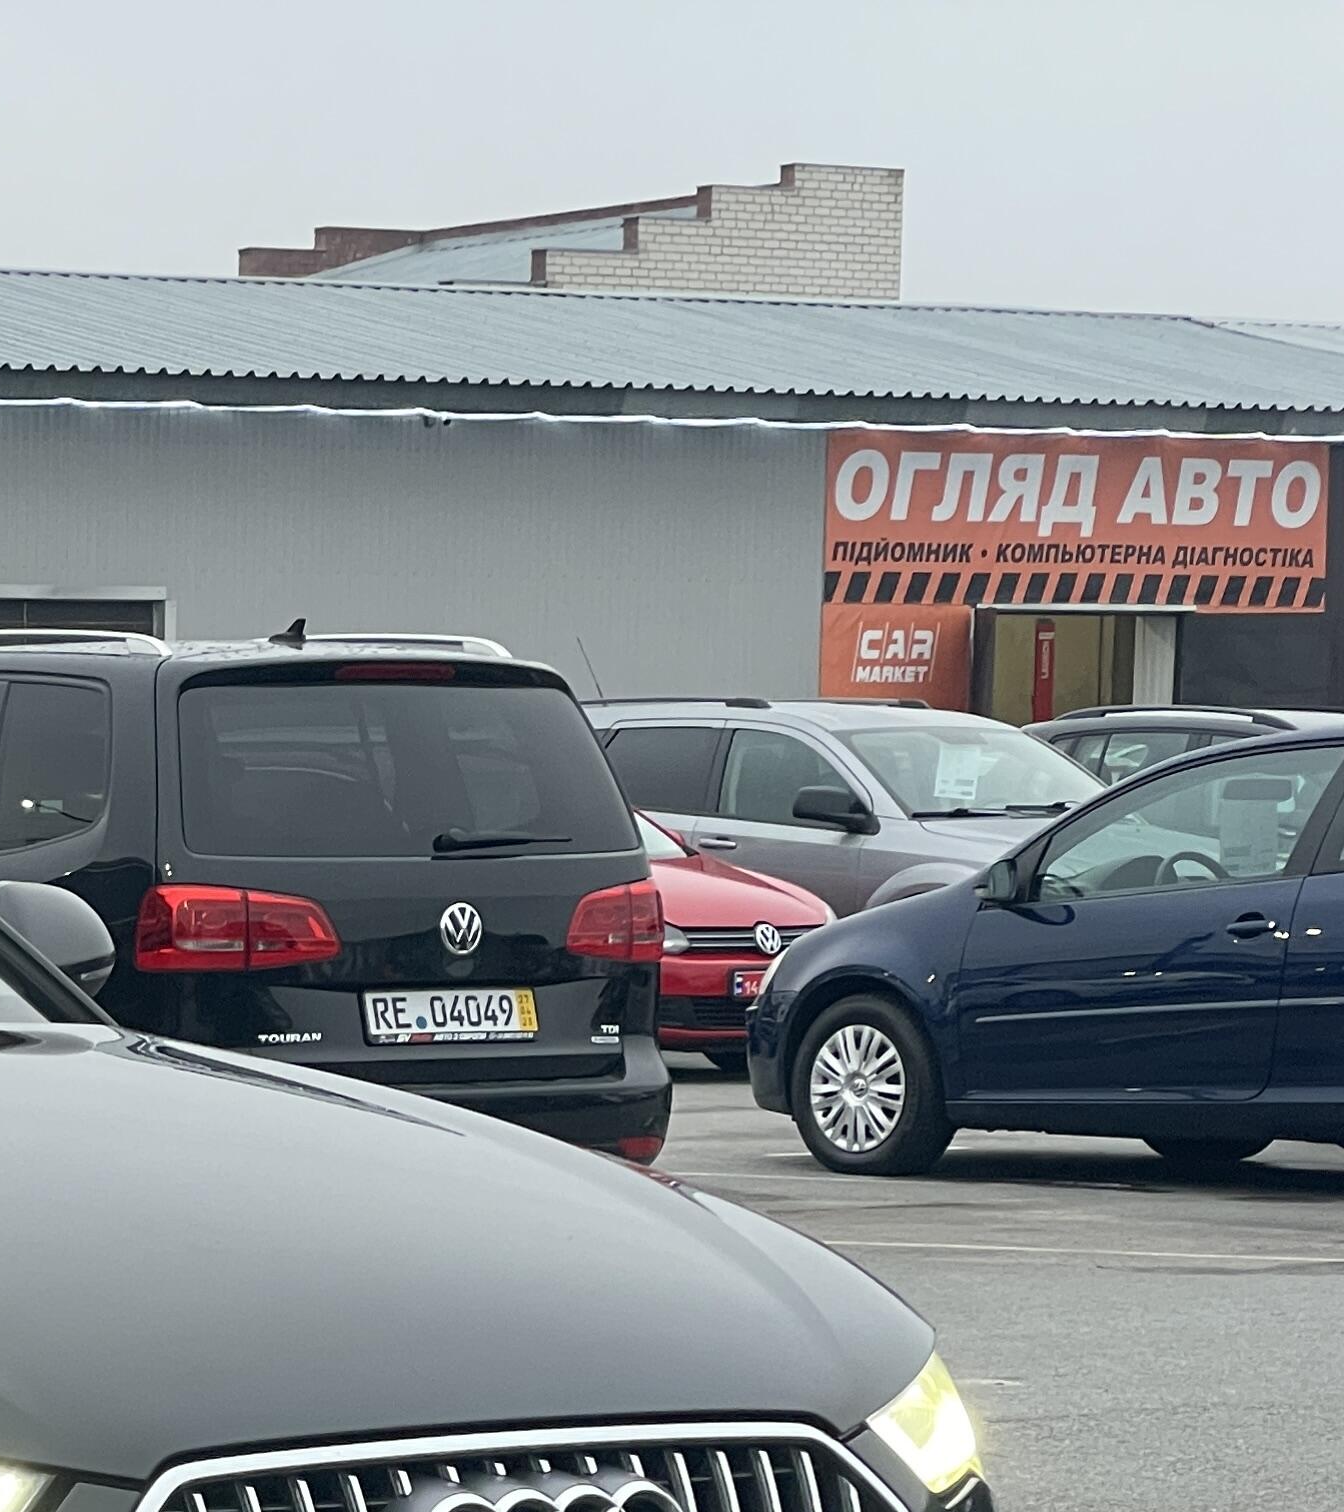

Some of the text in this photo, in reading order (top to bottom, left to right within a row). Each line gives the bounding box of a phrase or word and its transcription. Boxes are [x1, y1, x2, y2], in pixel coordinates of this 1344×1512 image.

[834, 449, 1321, 537] ОГЛЯД АВТО
[831, 540, 1315, 570] ПІДЙОМНИК КОМПЬЮТЕРНА ДІАГНОСТІКА
[859, 629, 935, 660] CAR
[855, 665, 929, 683] MARKET
[372, 994, 513, 1030] RE 04049
[257, 1032, 322, 1043] TOURAN
[600, 1024, 619, 1035] TDI
